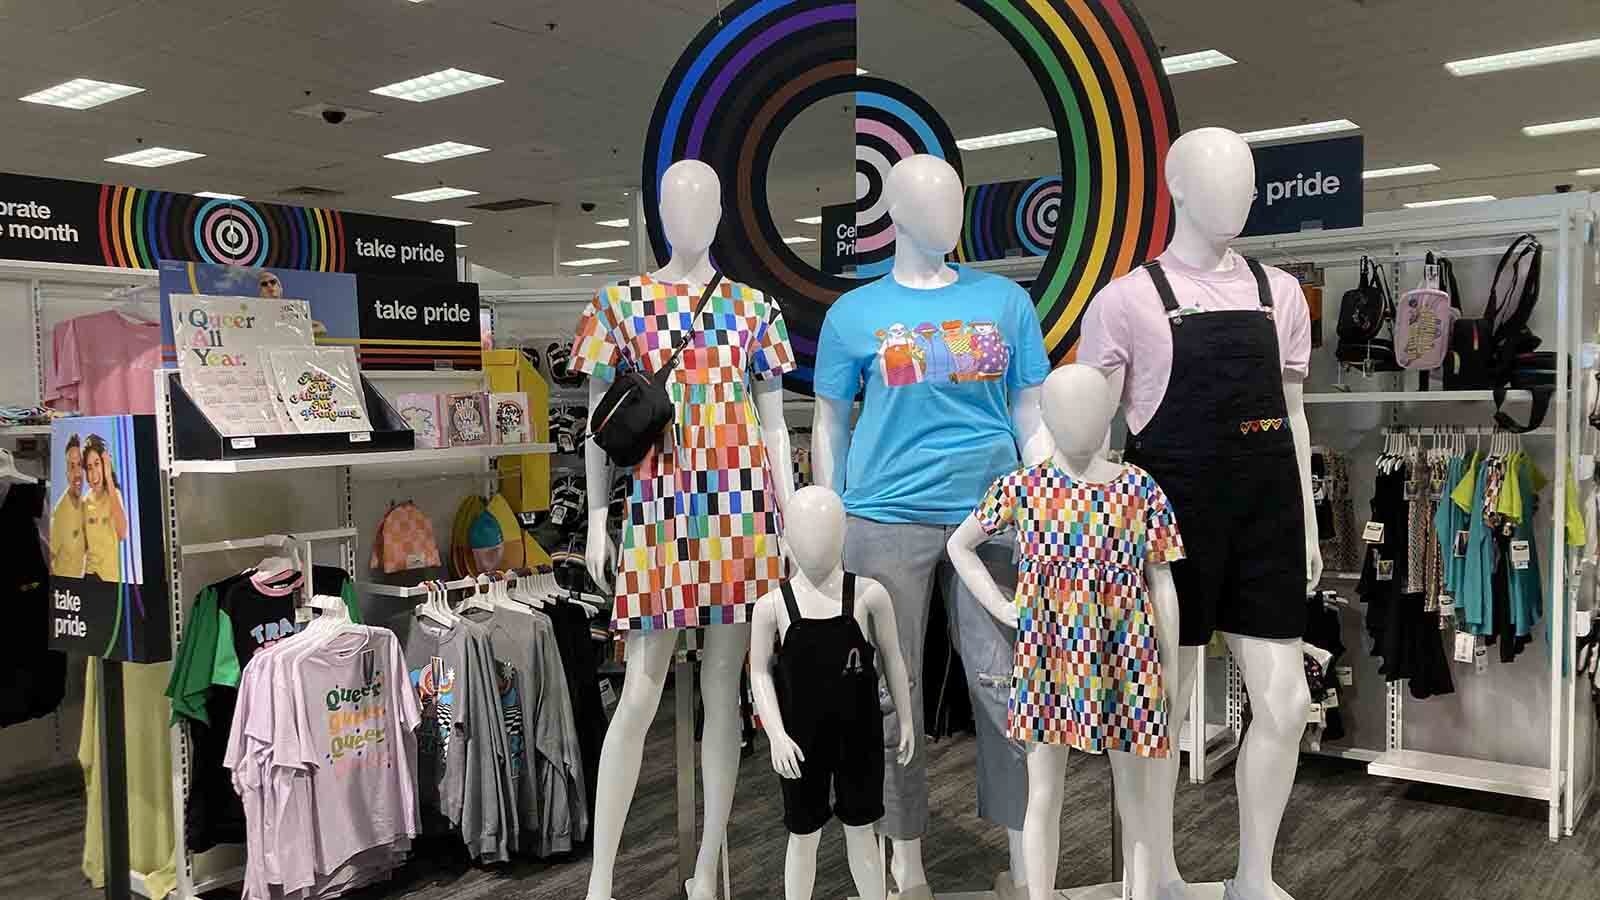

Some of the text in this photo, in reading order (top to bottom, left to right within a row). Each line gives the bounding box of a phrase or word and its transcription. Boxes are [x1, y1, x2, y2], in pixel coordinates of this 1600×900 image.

[1266, 171, 1341, 206] pride
[9, 223, 79, 242] month
[355, 238, 445, 263] take pride
[189, 309, 255, 330] Queer
[374, 300, 470, 325] take pride
[191, 329, 224, 347] All
[192, 348, 247, 366] Year.
[54, 589, 81, 612] take
[54, 613, 87, 638] pride
